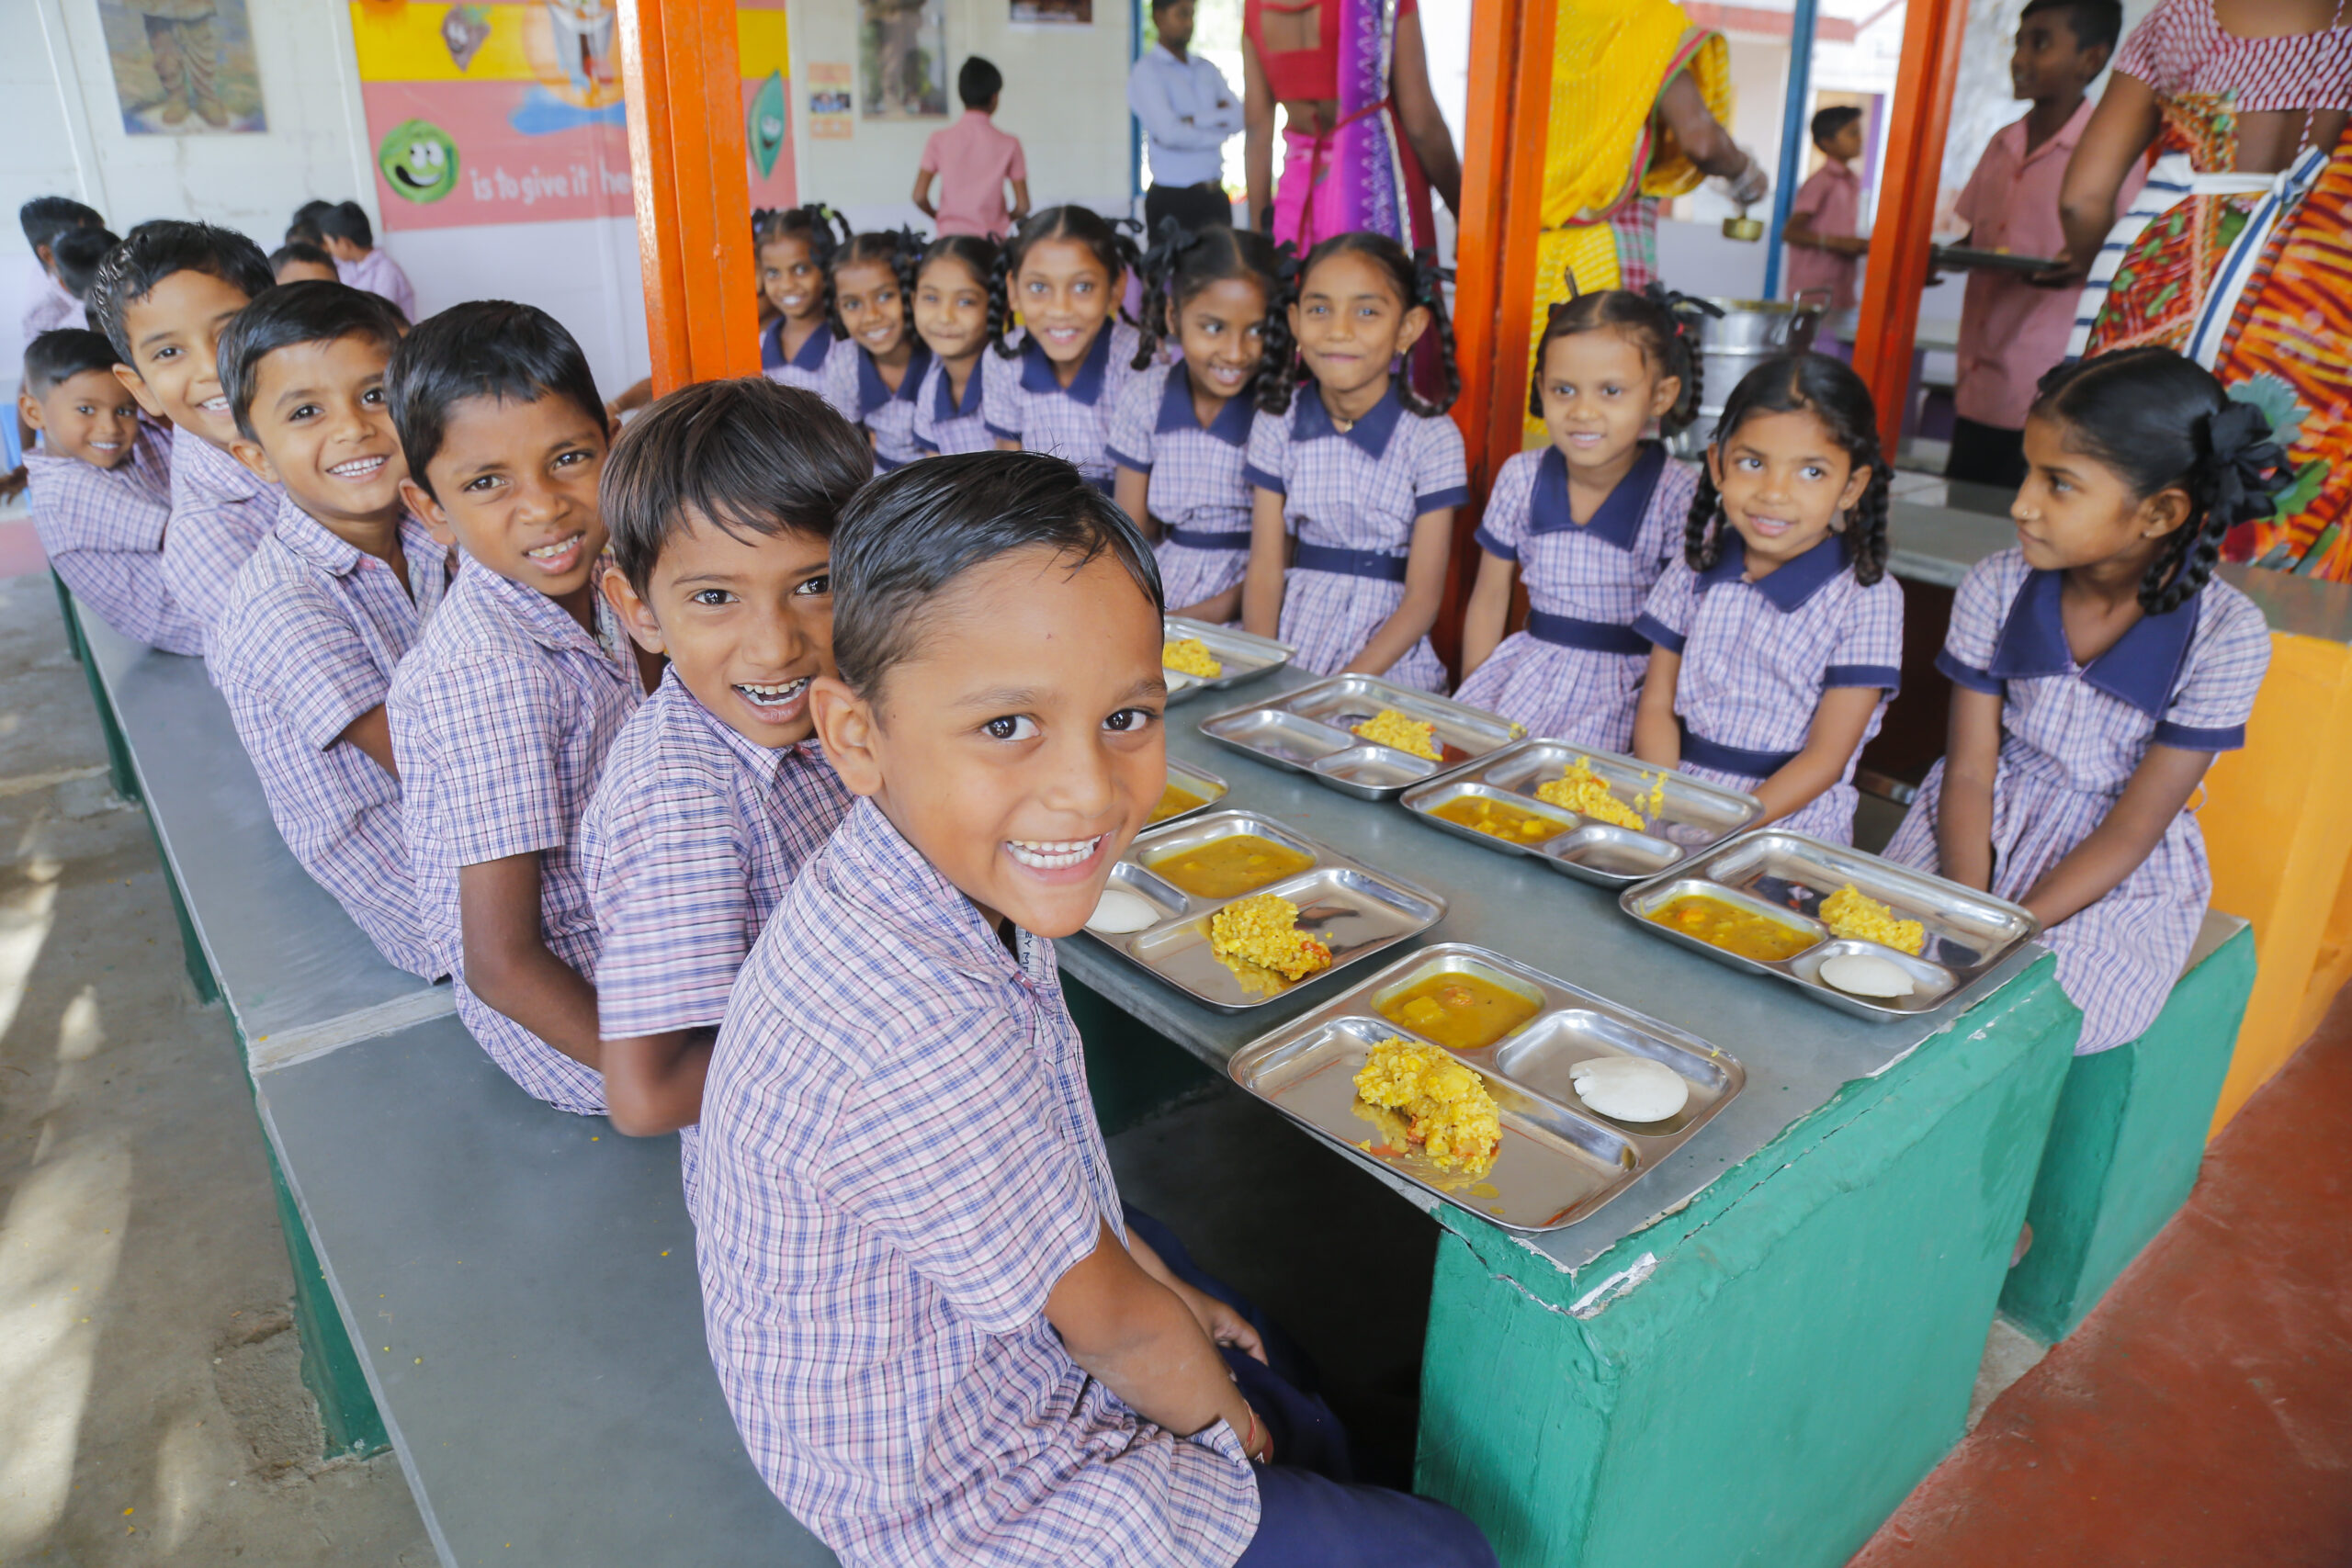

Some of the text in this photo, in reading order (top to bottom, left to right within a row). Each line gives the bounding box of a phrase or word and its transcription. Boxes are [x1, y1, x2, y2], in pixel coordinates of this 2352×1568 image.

[469, 154, 633, 206] is to give it he
